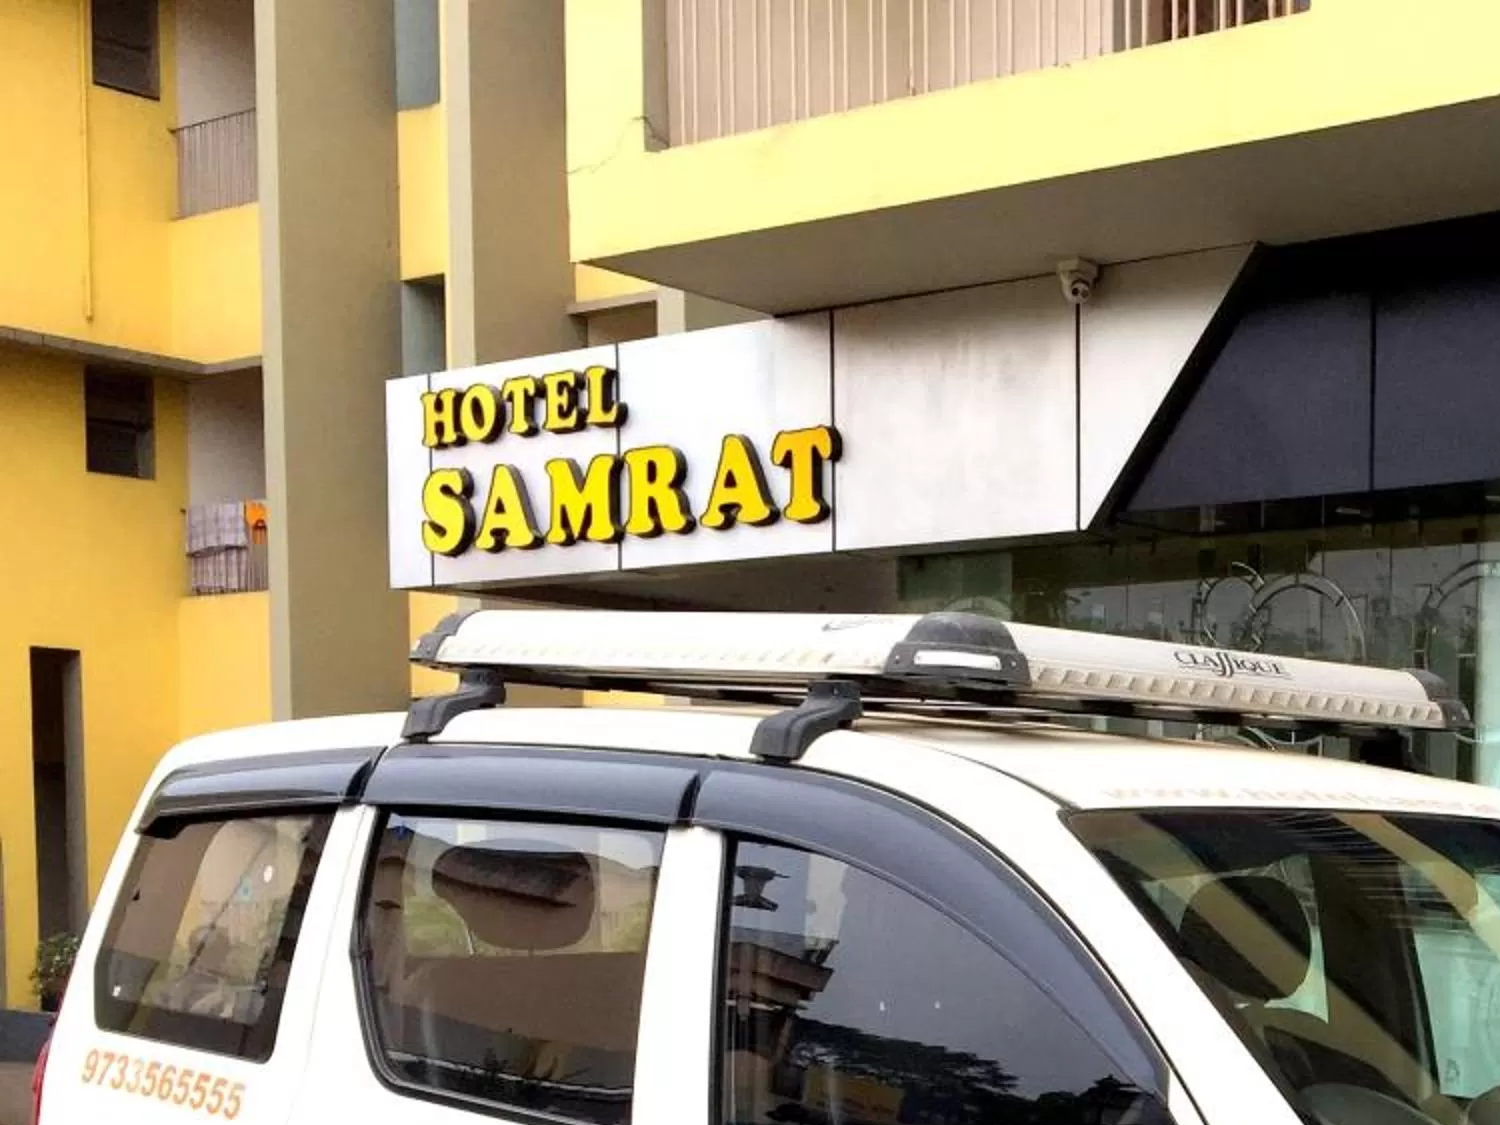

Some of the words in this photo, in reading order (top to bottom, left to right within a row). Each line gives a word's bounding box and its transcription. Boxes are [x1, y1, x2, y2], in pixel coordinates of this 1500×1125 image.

[420, 365, 627, 448] HOTEL
[420, 424, 842, 556] SAMRAT
[81, 1047, 247, 1121] 9733565555
